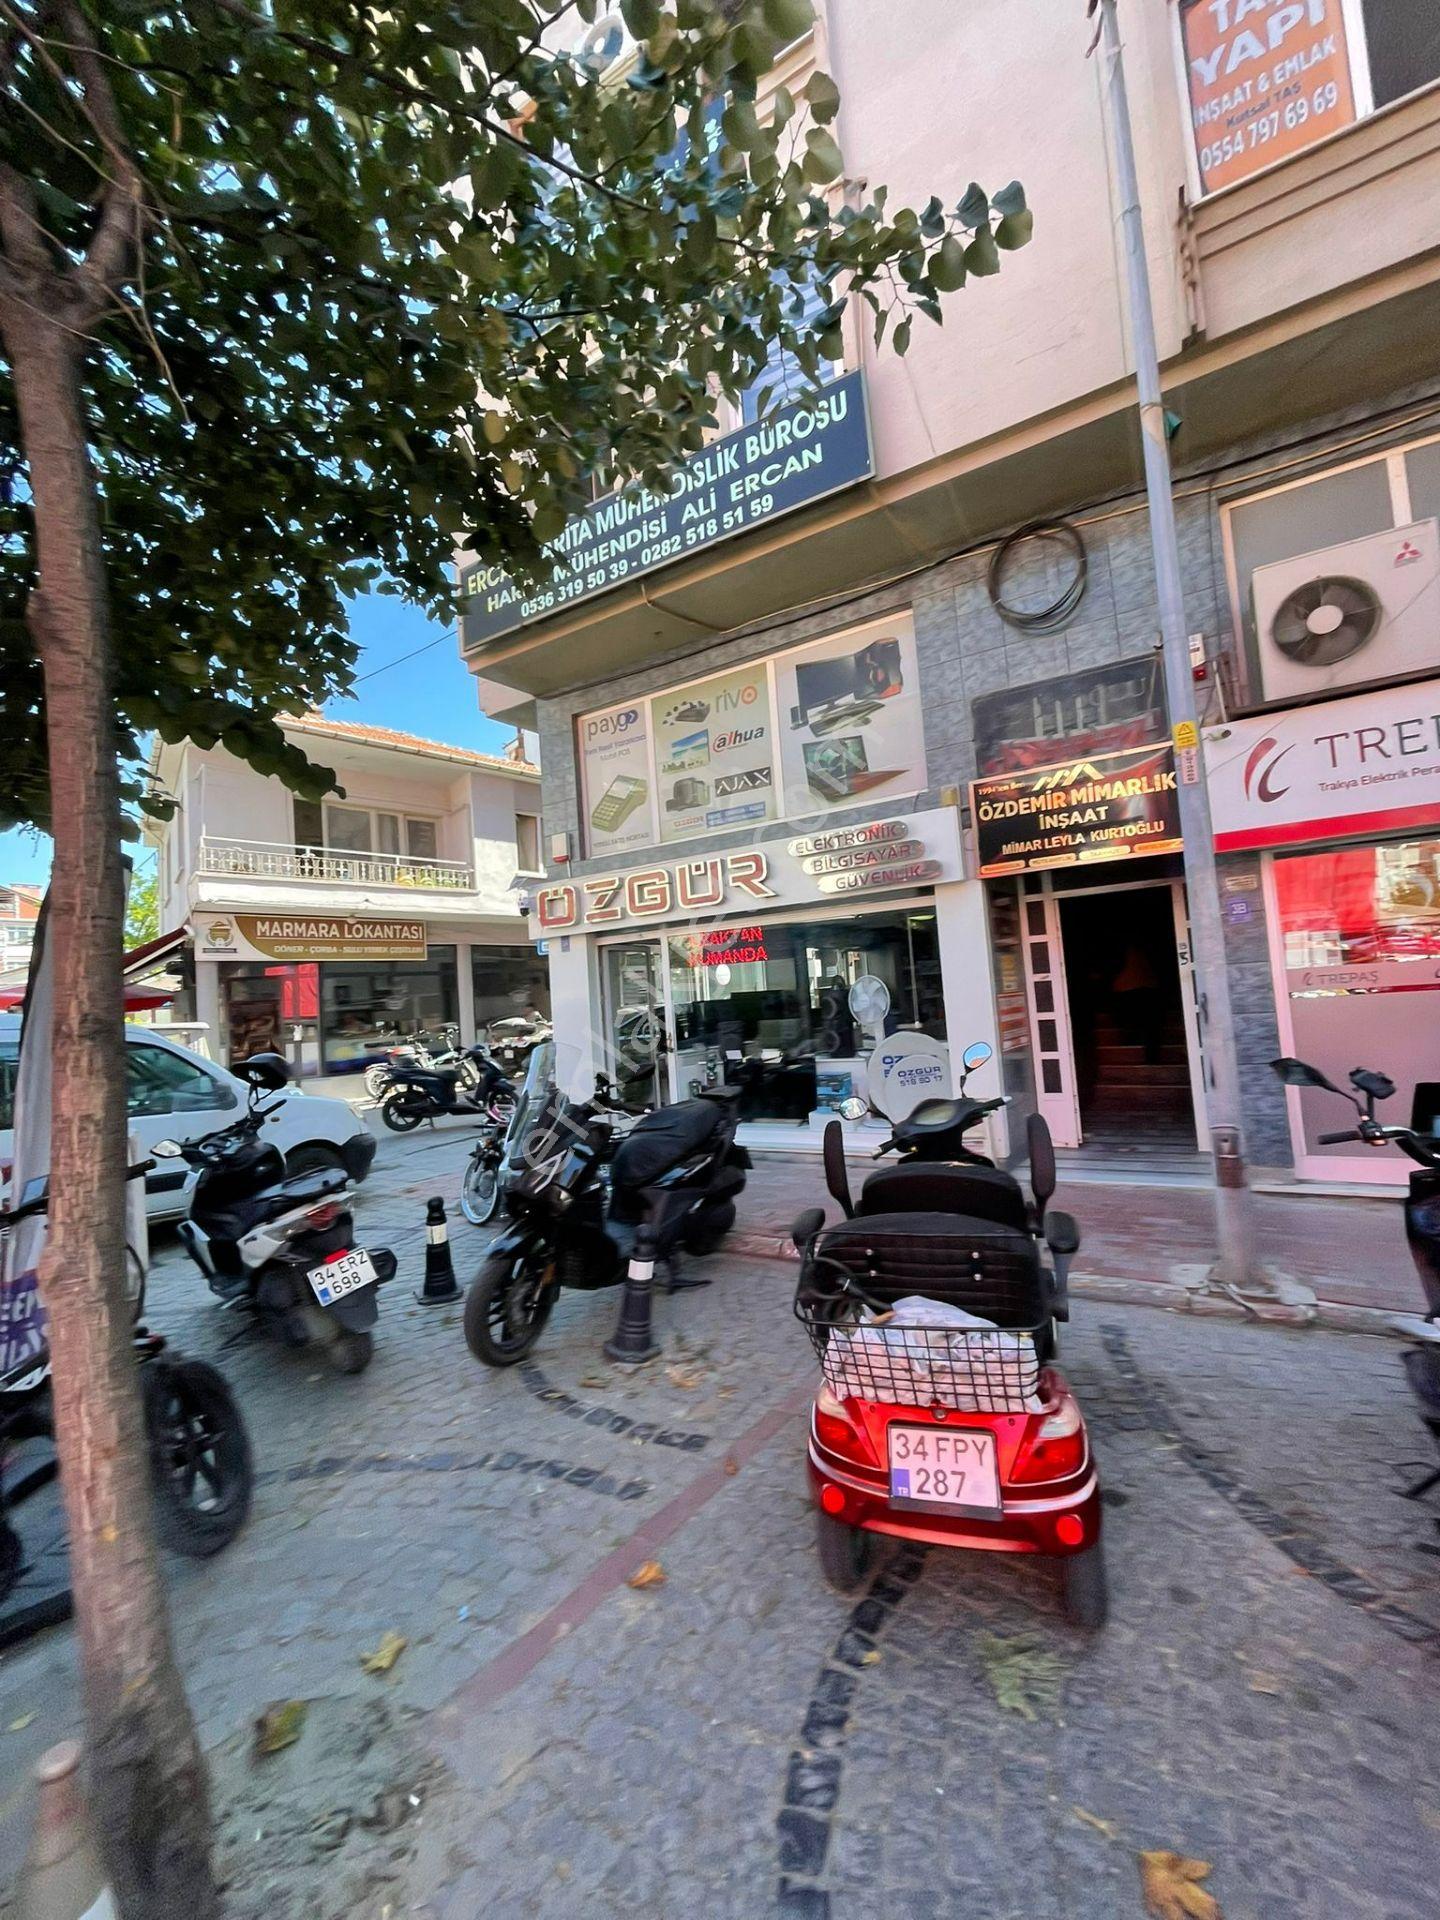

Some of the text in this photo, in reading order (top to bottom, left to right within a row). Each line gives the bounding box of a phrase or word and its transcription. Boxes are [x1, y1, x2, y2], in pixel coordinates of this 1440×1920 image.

[1190, 0, 1326, 87] YAPI
[1200, 81, 1338, 172] 0554 797 69 69
[745, 389, 848, 465] BÜROSU
[681, 486, 716, 525] ALİ
[730, 443, 823, 502] ERCAN
[521, 591, 554, 617] 0536
[557, 578, 583, 602] 319
[587, 568, 606, 589] 50
[610, 558, 628, 580] 39
[641, 534, 682, 565] 0282
[686, 517, 718, 546] 518
[723, 506, 744, 529] 51
[750, 493, 774, 519] 59
[1314, 713, 1440, 768] TRE
[717, 769, 769, 795] AJAX
[978, 771, 1177, 822] ÖZDEMİR MİMARLIK
[1039, 805, 1109, 830] İNŞAAT
[795, 823, 897, 854] ELEKTRONİK
[1002, 820, 1165, 856] MİMAR LEYLA KURTOĞLU
[537, 851, 777, 929] ÖZGÜR
[835, 865, 921, 890] GÜVENLİK
[256, 919, 424, 941] MARMARA LOKANTASI
[314, 1251, 368, 1285] 34 ERZ
[332, 1271, 361, 1294] 698
[895, 1433, 988, 1467] 34 FPY
[915, 1467, 967, 1498] 287
